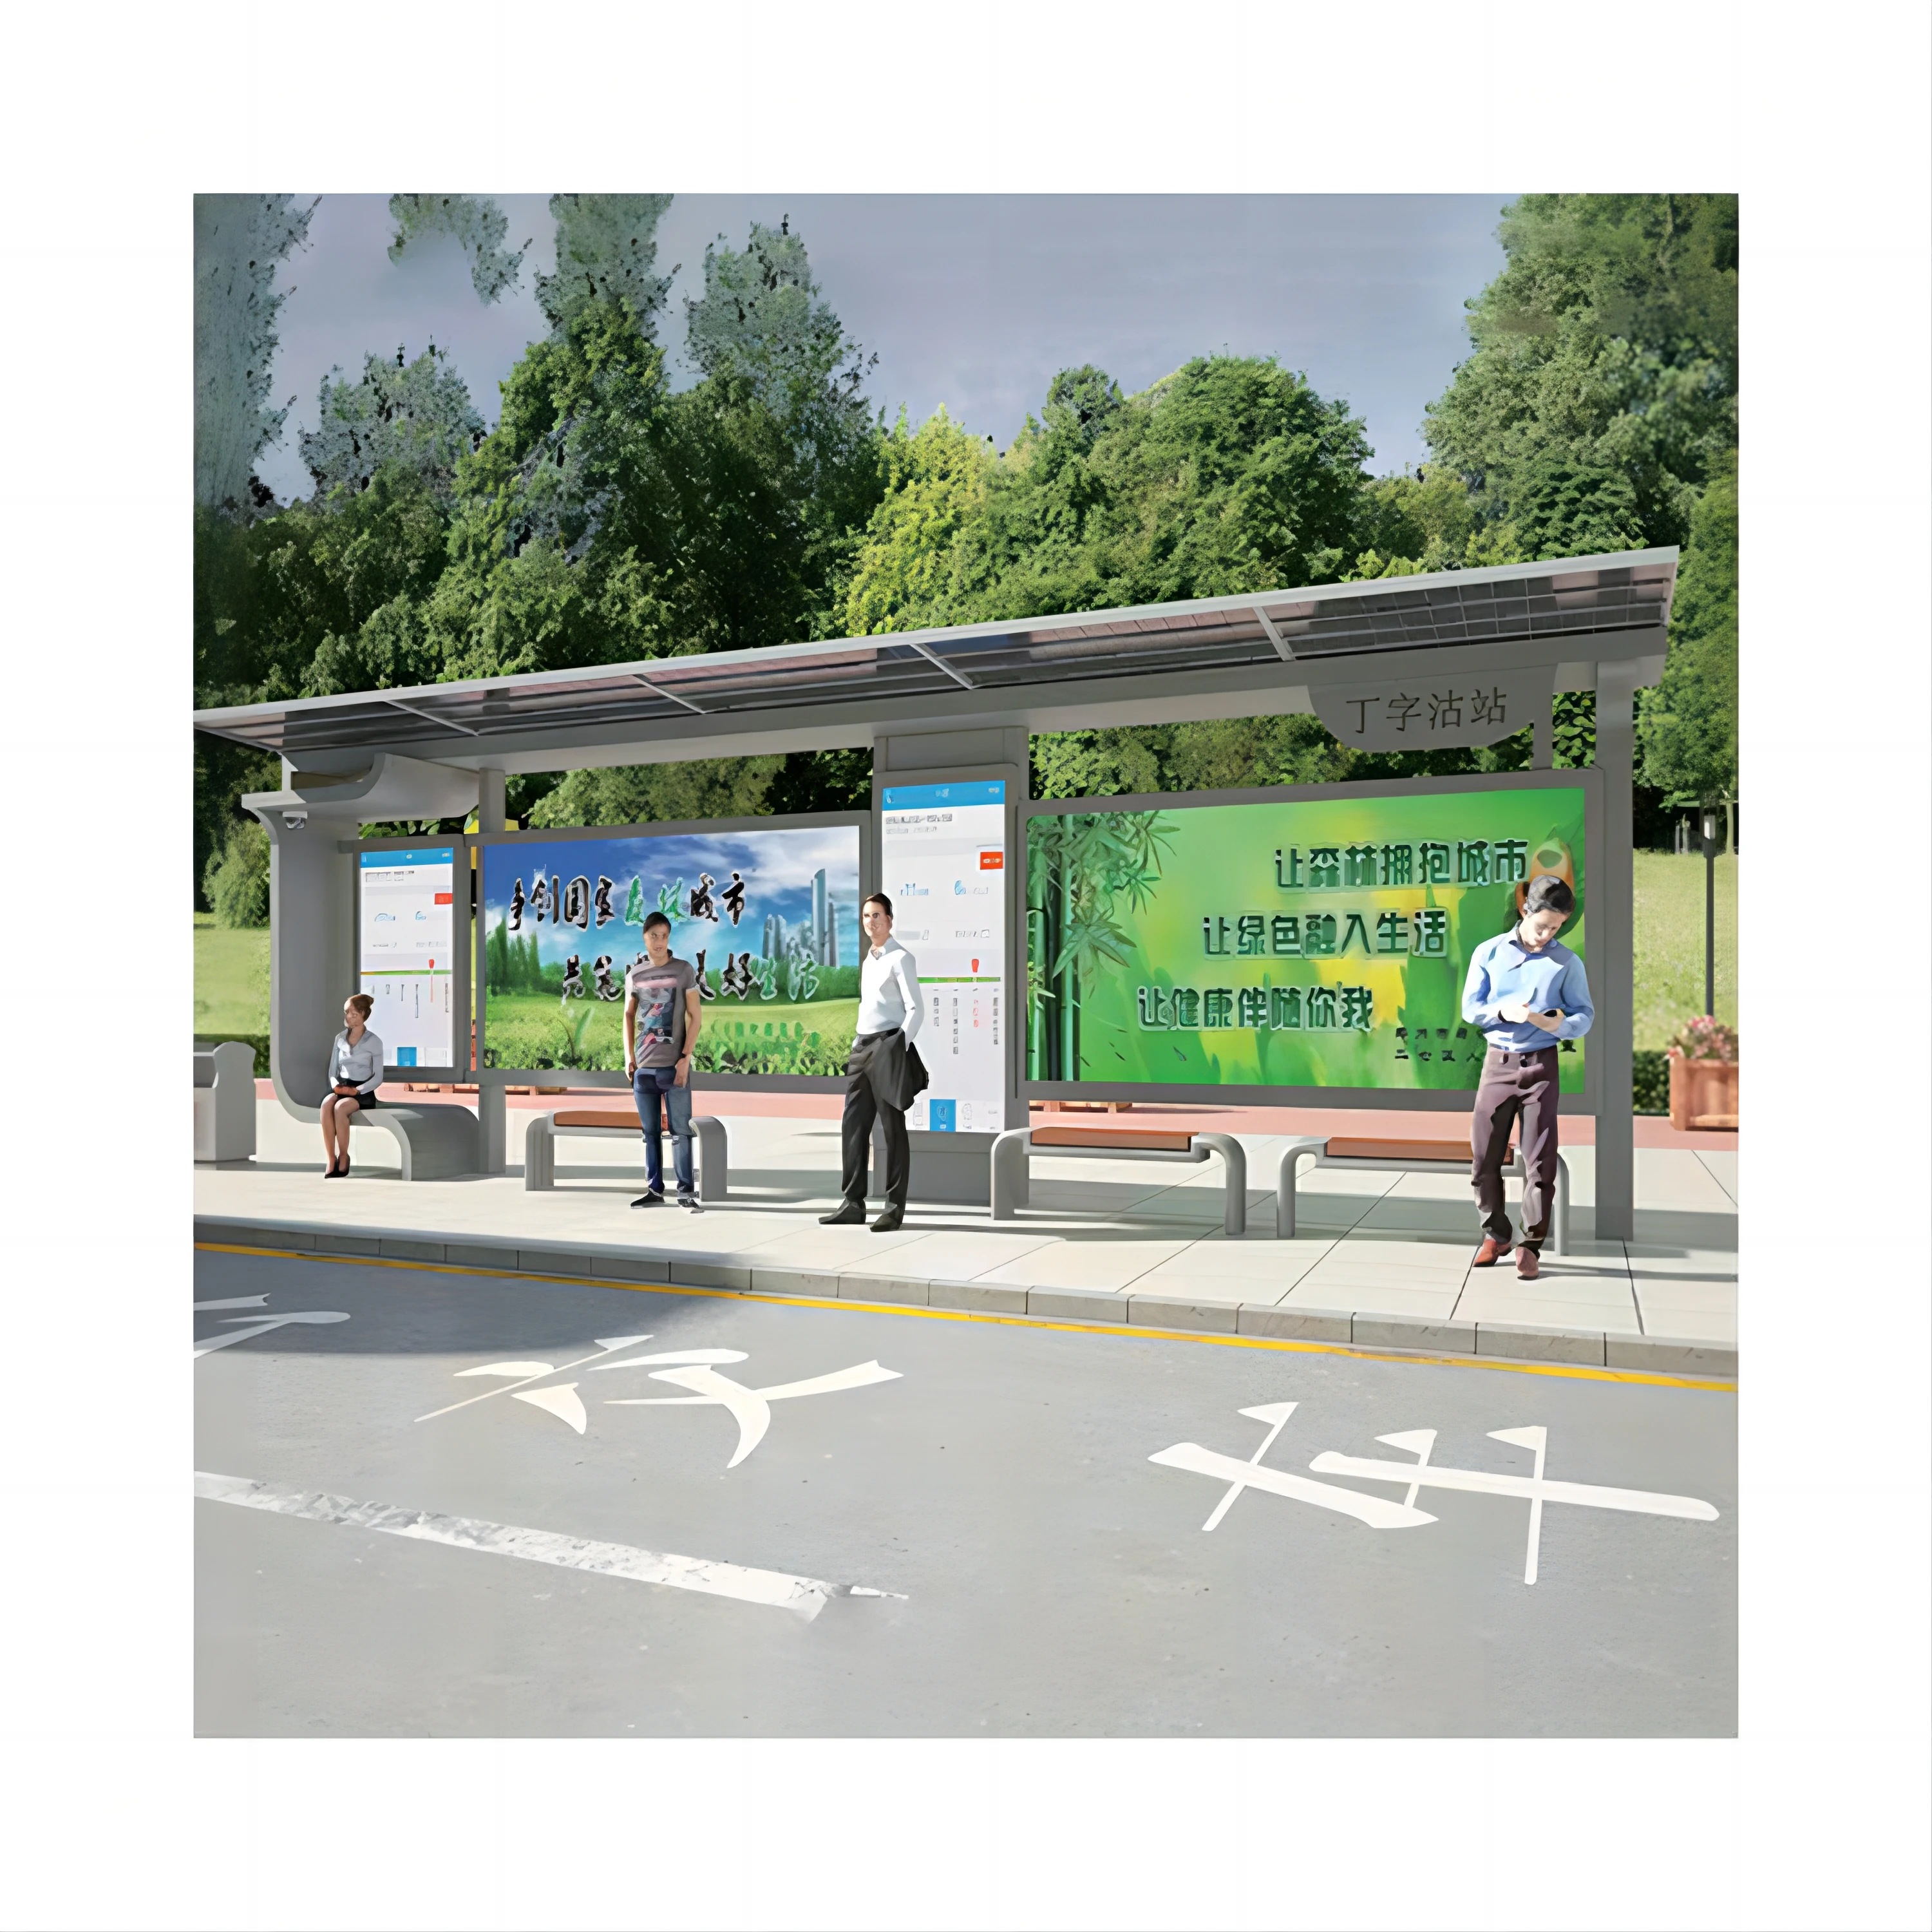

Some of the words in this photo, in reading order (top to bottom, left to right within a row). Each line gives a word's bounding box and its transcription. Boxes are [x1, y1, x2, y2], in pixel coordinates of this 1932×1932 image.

[1346, 687, 1507, 734] 丁字沽站
[1274, 838, 1530, 888] 让森林拥抱城市
[1203, 910, 1448, 956] 让绿色融入生活
[1137, 985, 1373, 1030] 让健康伴随你我
